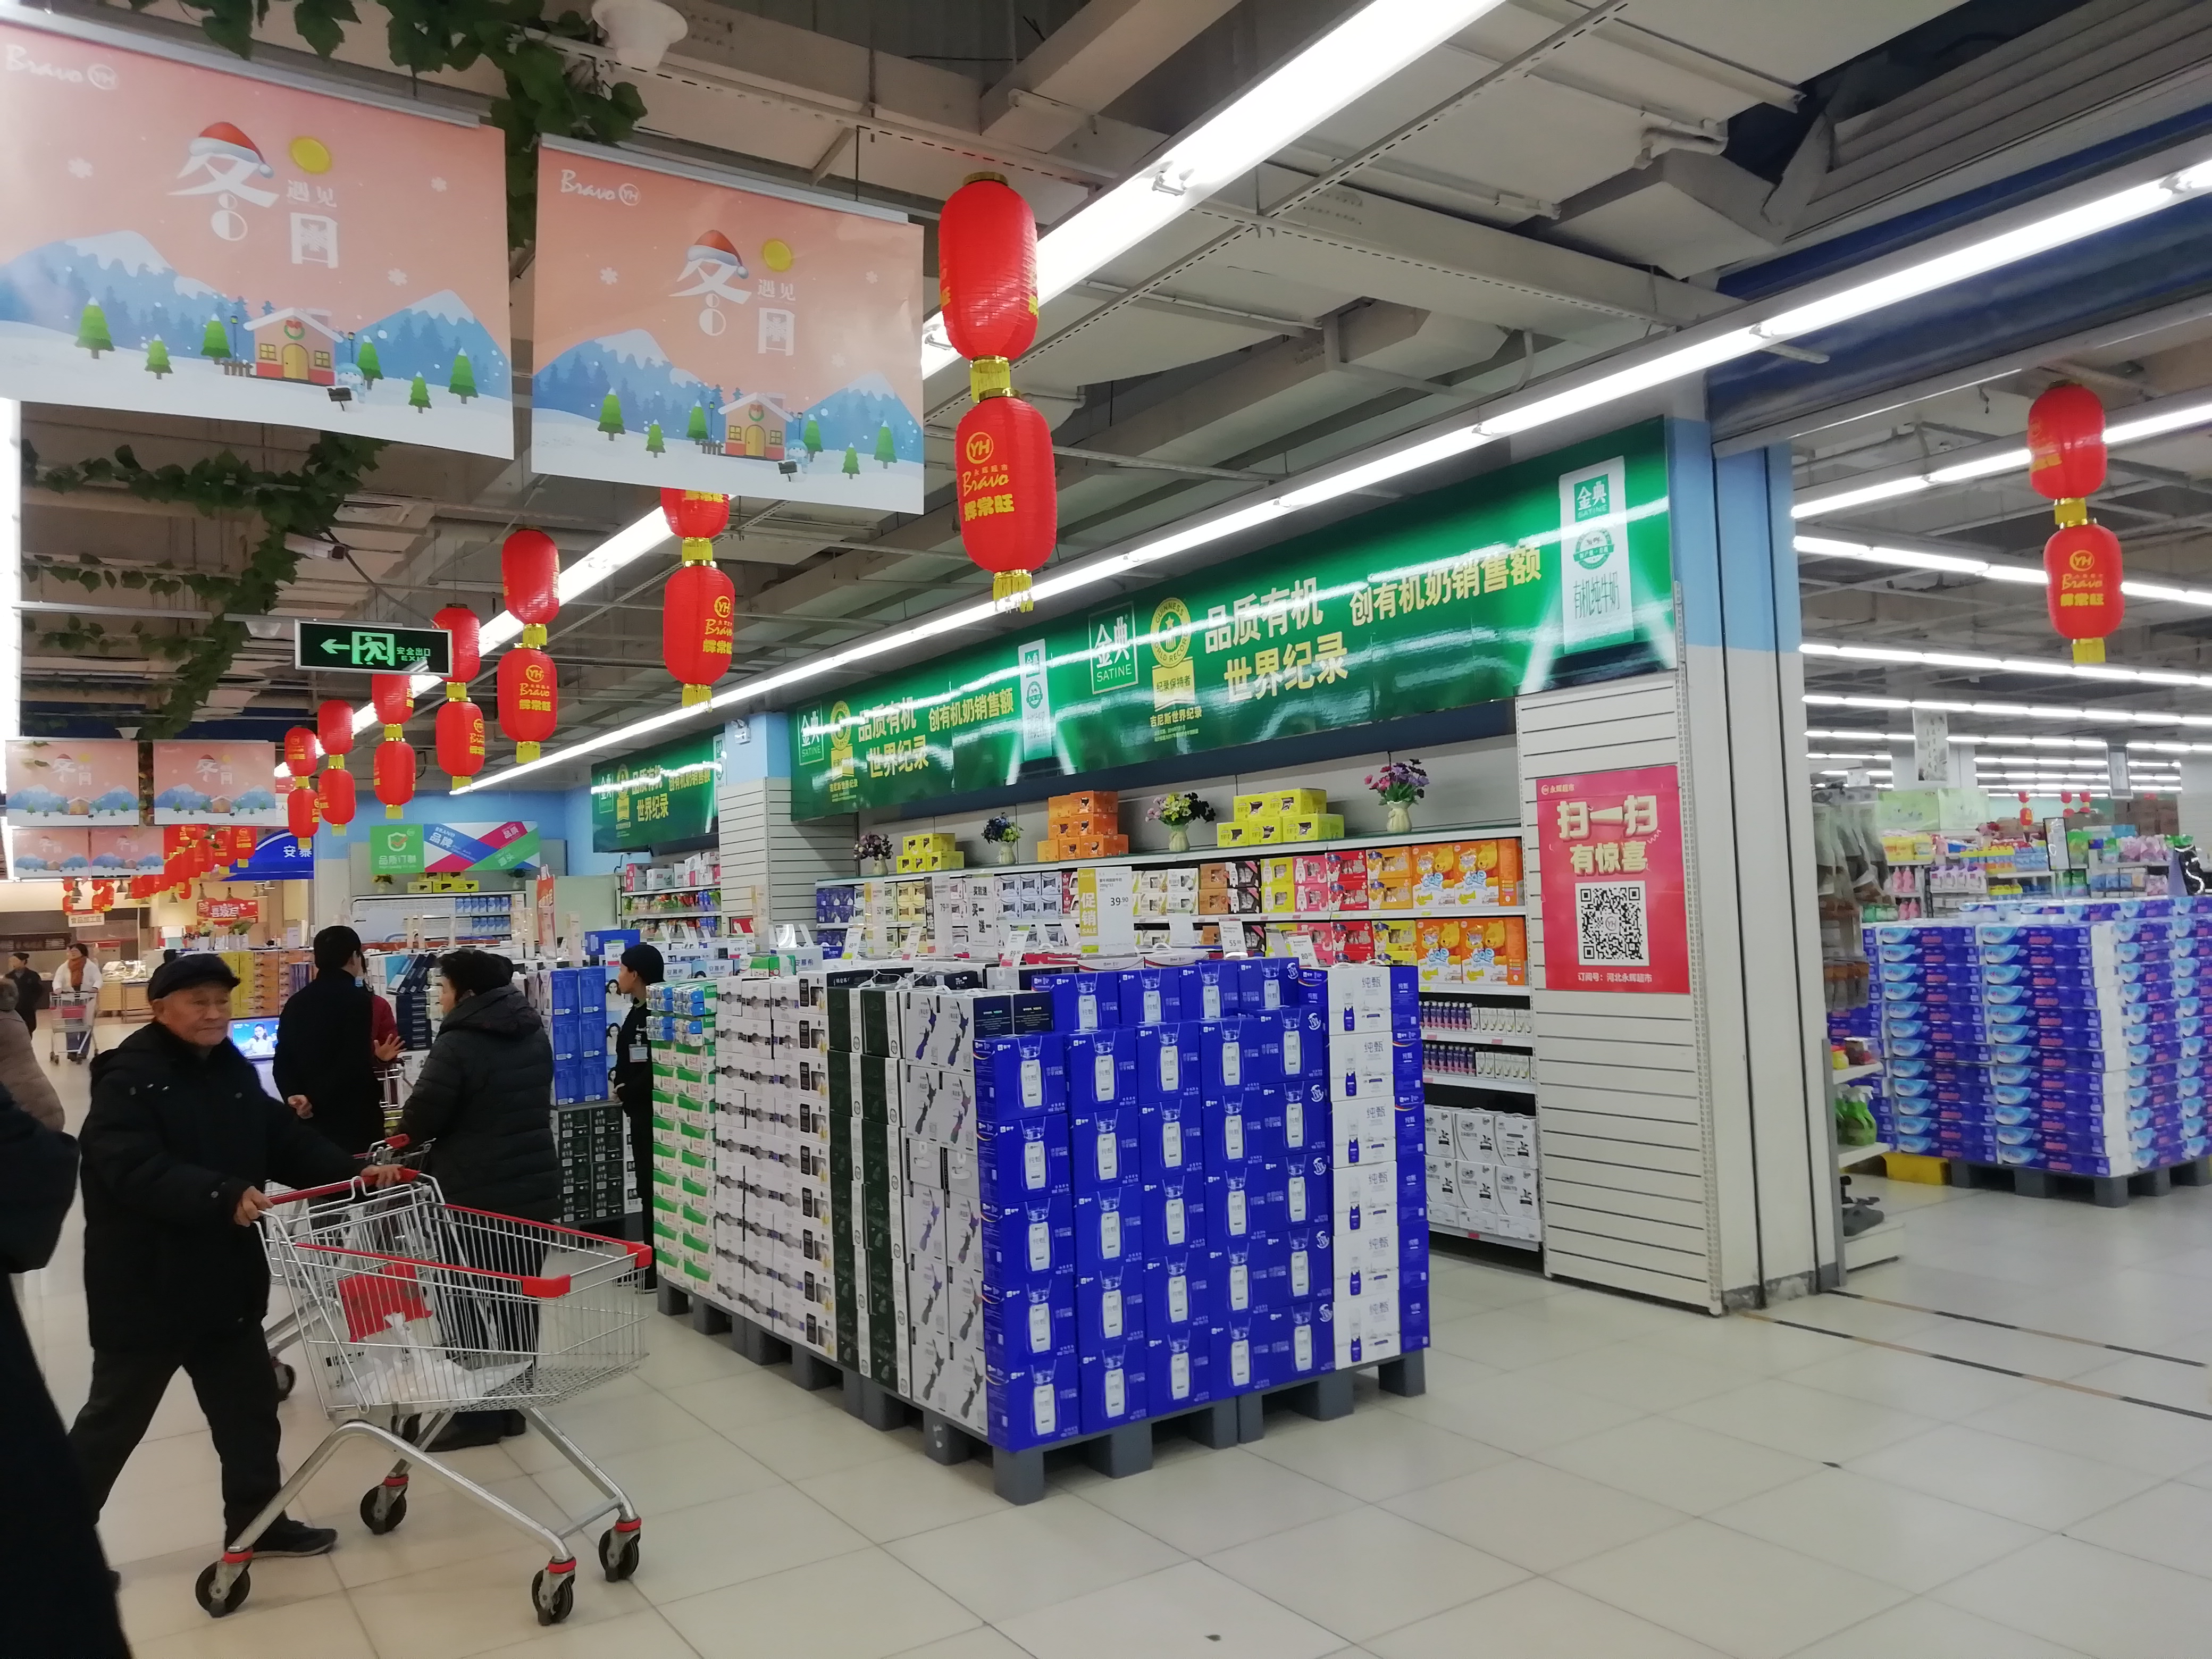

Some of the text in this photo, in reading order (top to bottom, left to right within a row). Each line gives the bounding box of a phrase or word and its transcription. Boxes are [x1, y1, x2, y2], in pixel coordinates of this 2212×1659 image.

[6, 44, 83, 82] Bravo
[286, 179, 338, 208] 遇见
[560, 169, 615, 200] Bravo
[757, 278, 796, 301] 遇见
[961, 471, 1010, 497] Bravo
[1577, 480, 1607, 511] 金典
[1349, 543, 1542, 626] 创有机奶销售额
[2061, 573, 2104, 590] Bravo
[1155, 602, 1184, 624] GUINNESS
[1205, 577, 1324, 654] 品质有机
[397, 646, 431, 657] 安全出口
[1093, 615, 1130, 669] 金典
[1096, 664, 1133, 683] SATINE
[1224, 631, 1348, 703] 世界纪录
[519, 683, 550, 697] Bravo
[1156, 675, 1191, 692] 纪录保持者
[928, 688, 1014, 732] 创有机奶销售额
[1150, 706, 1202, 727] 吉尼斯世界纪录
[801, 746, 822, 757] SATINE
[867, 734, 929, 778] 世界纪录
[636, 793, 669, 822] 世界纪录
[1557, 794, 1658, 840] 扫一扫
[429, 832, 454, 849] 品牌
[378, 854, 417, 866] 品质订制
[1570, 841, 1648, 876] 有惊喜
[1080, 892, 1096, 926] 促销
[1362, 976, 1381, 988] 纯甄
[1364, 1041, 1384, 1053] 纯甄
[1367, 1106, 1386, 1119] 纯甄
[1368, 1171, 1388, 1185] 纯甄
